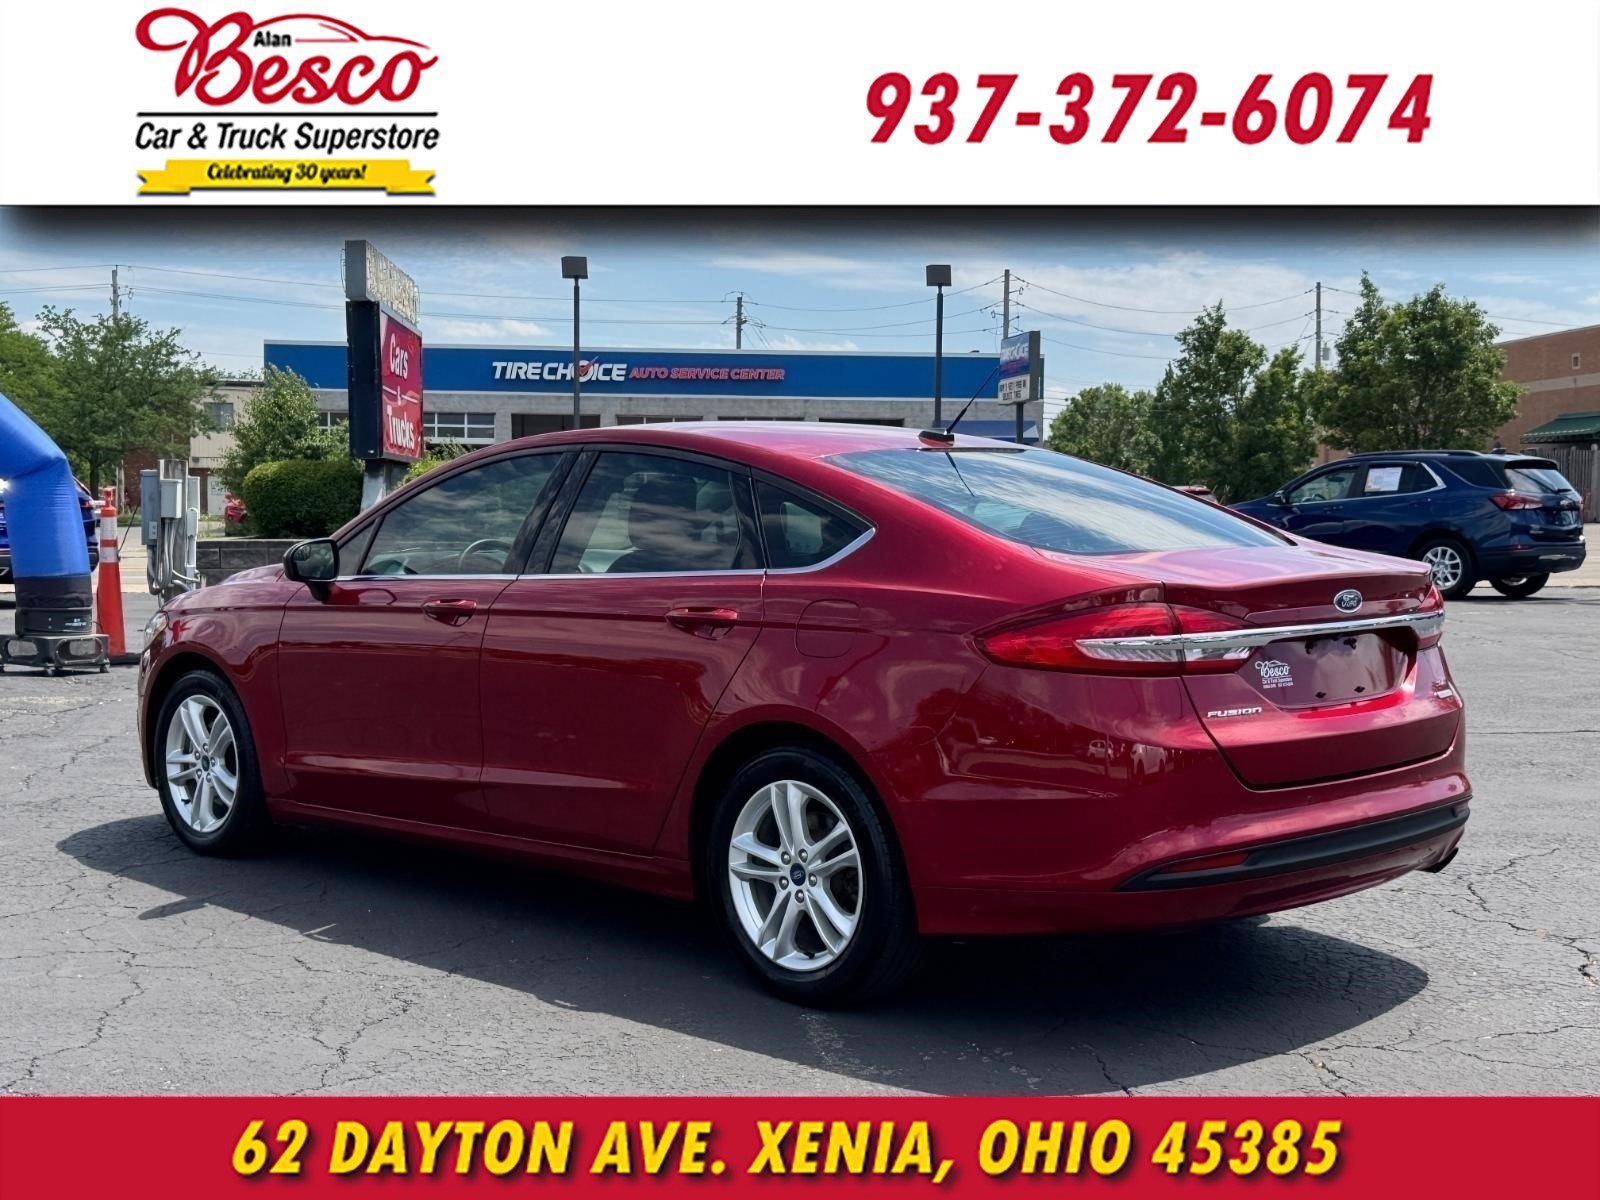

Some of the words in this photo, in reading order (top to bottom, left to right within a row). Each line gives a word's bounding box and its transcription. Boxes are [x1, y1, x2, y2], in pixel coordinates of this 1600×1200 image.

[390, 333, 408, 380] Cars
[629, 367, 668, 379] AUTO
[670, 368, 729, 380] SERVICE
[730, 369, 786, 380] CENTER
[387, 404, 415, 450] Trucks
[1255, 660, 1290, 678] Besco
[1207, 707, 1262, 718] FUSION
